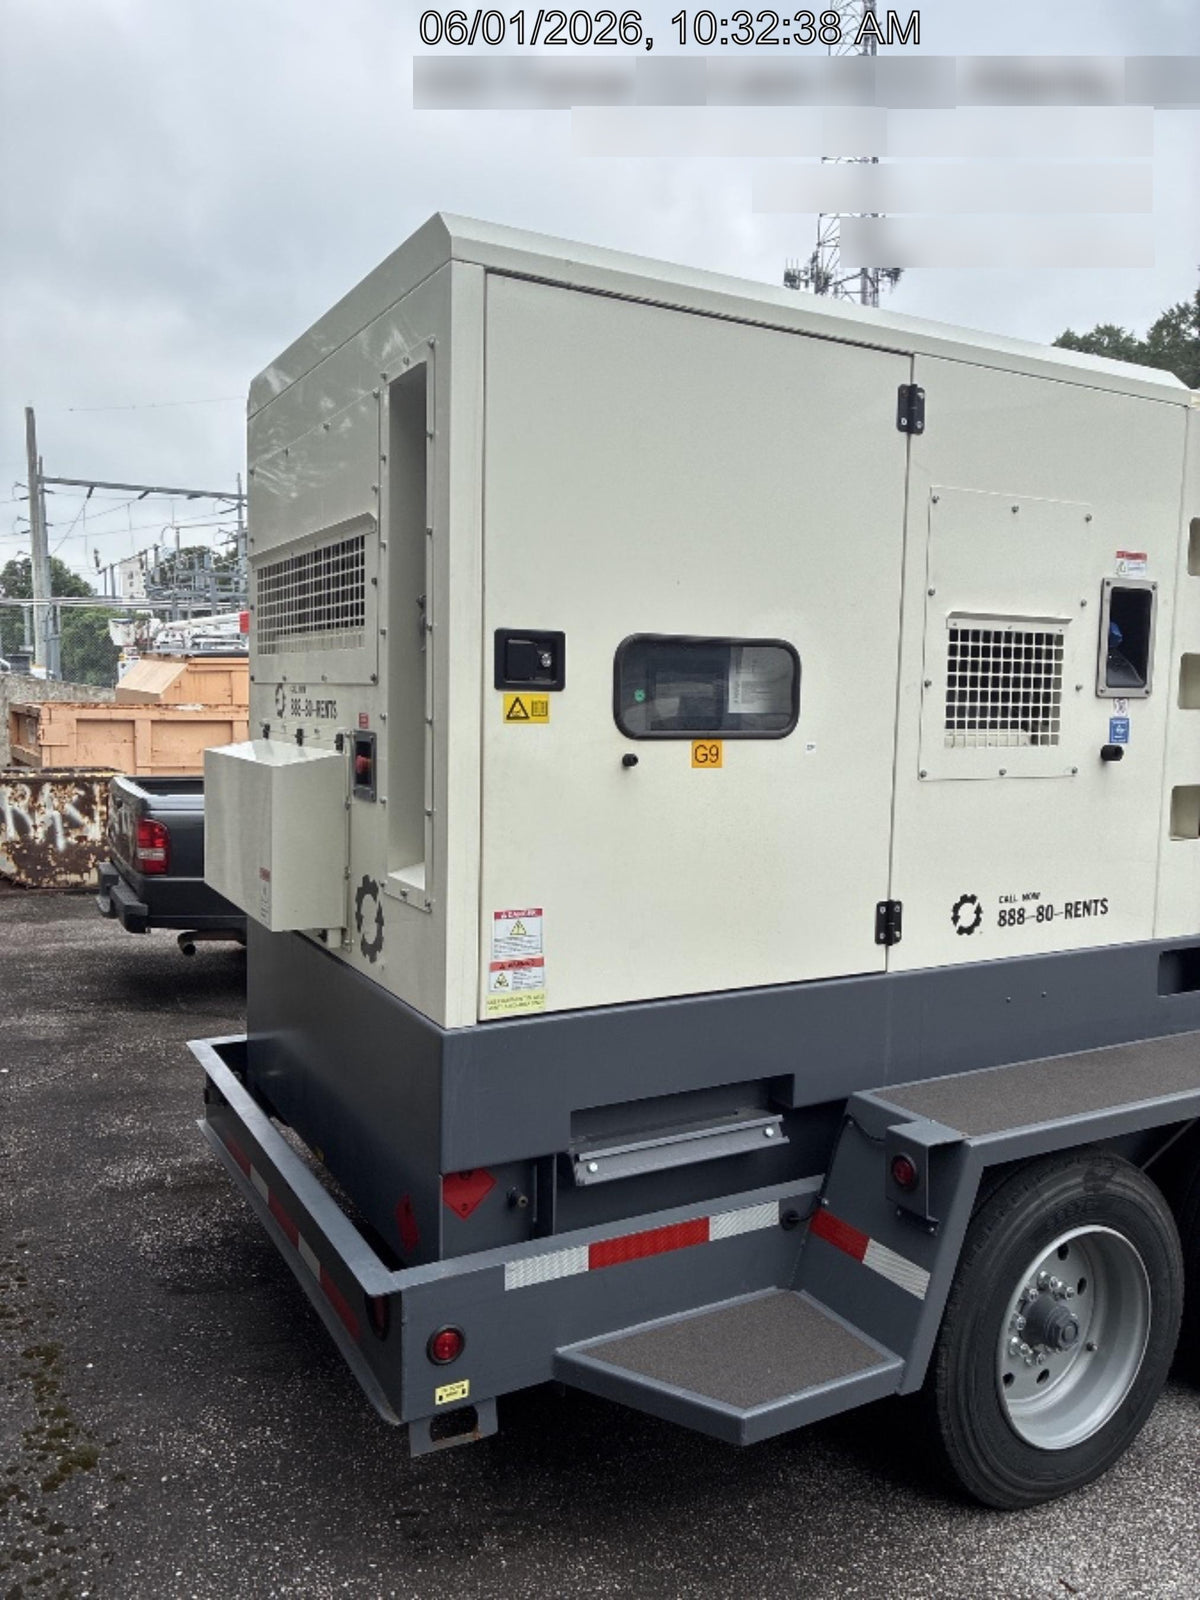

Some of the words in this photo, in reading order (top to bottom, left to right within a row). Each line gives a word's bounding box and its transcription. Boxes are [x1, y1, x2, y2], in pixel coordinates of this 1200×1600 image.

[694, 744, 719, 764] G9
[999, 894, 1018, 904] CALL
[1022, 892, 1041, 901] NOW
[997, 898, 1109, 927] 888-80-RENTS
